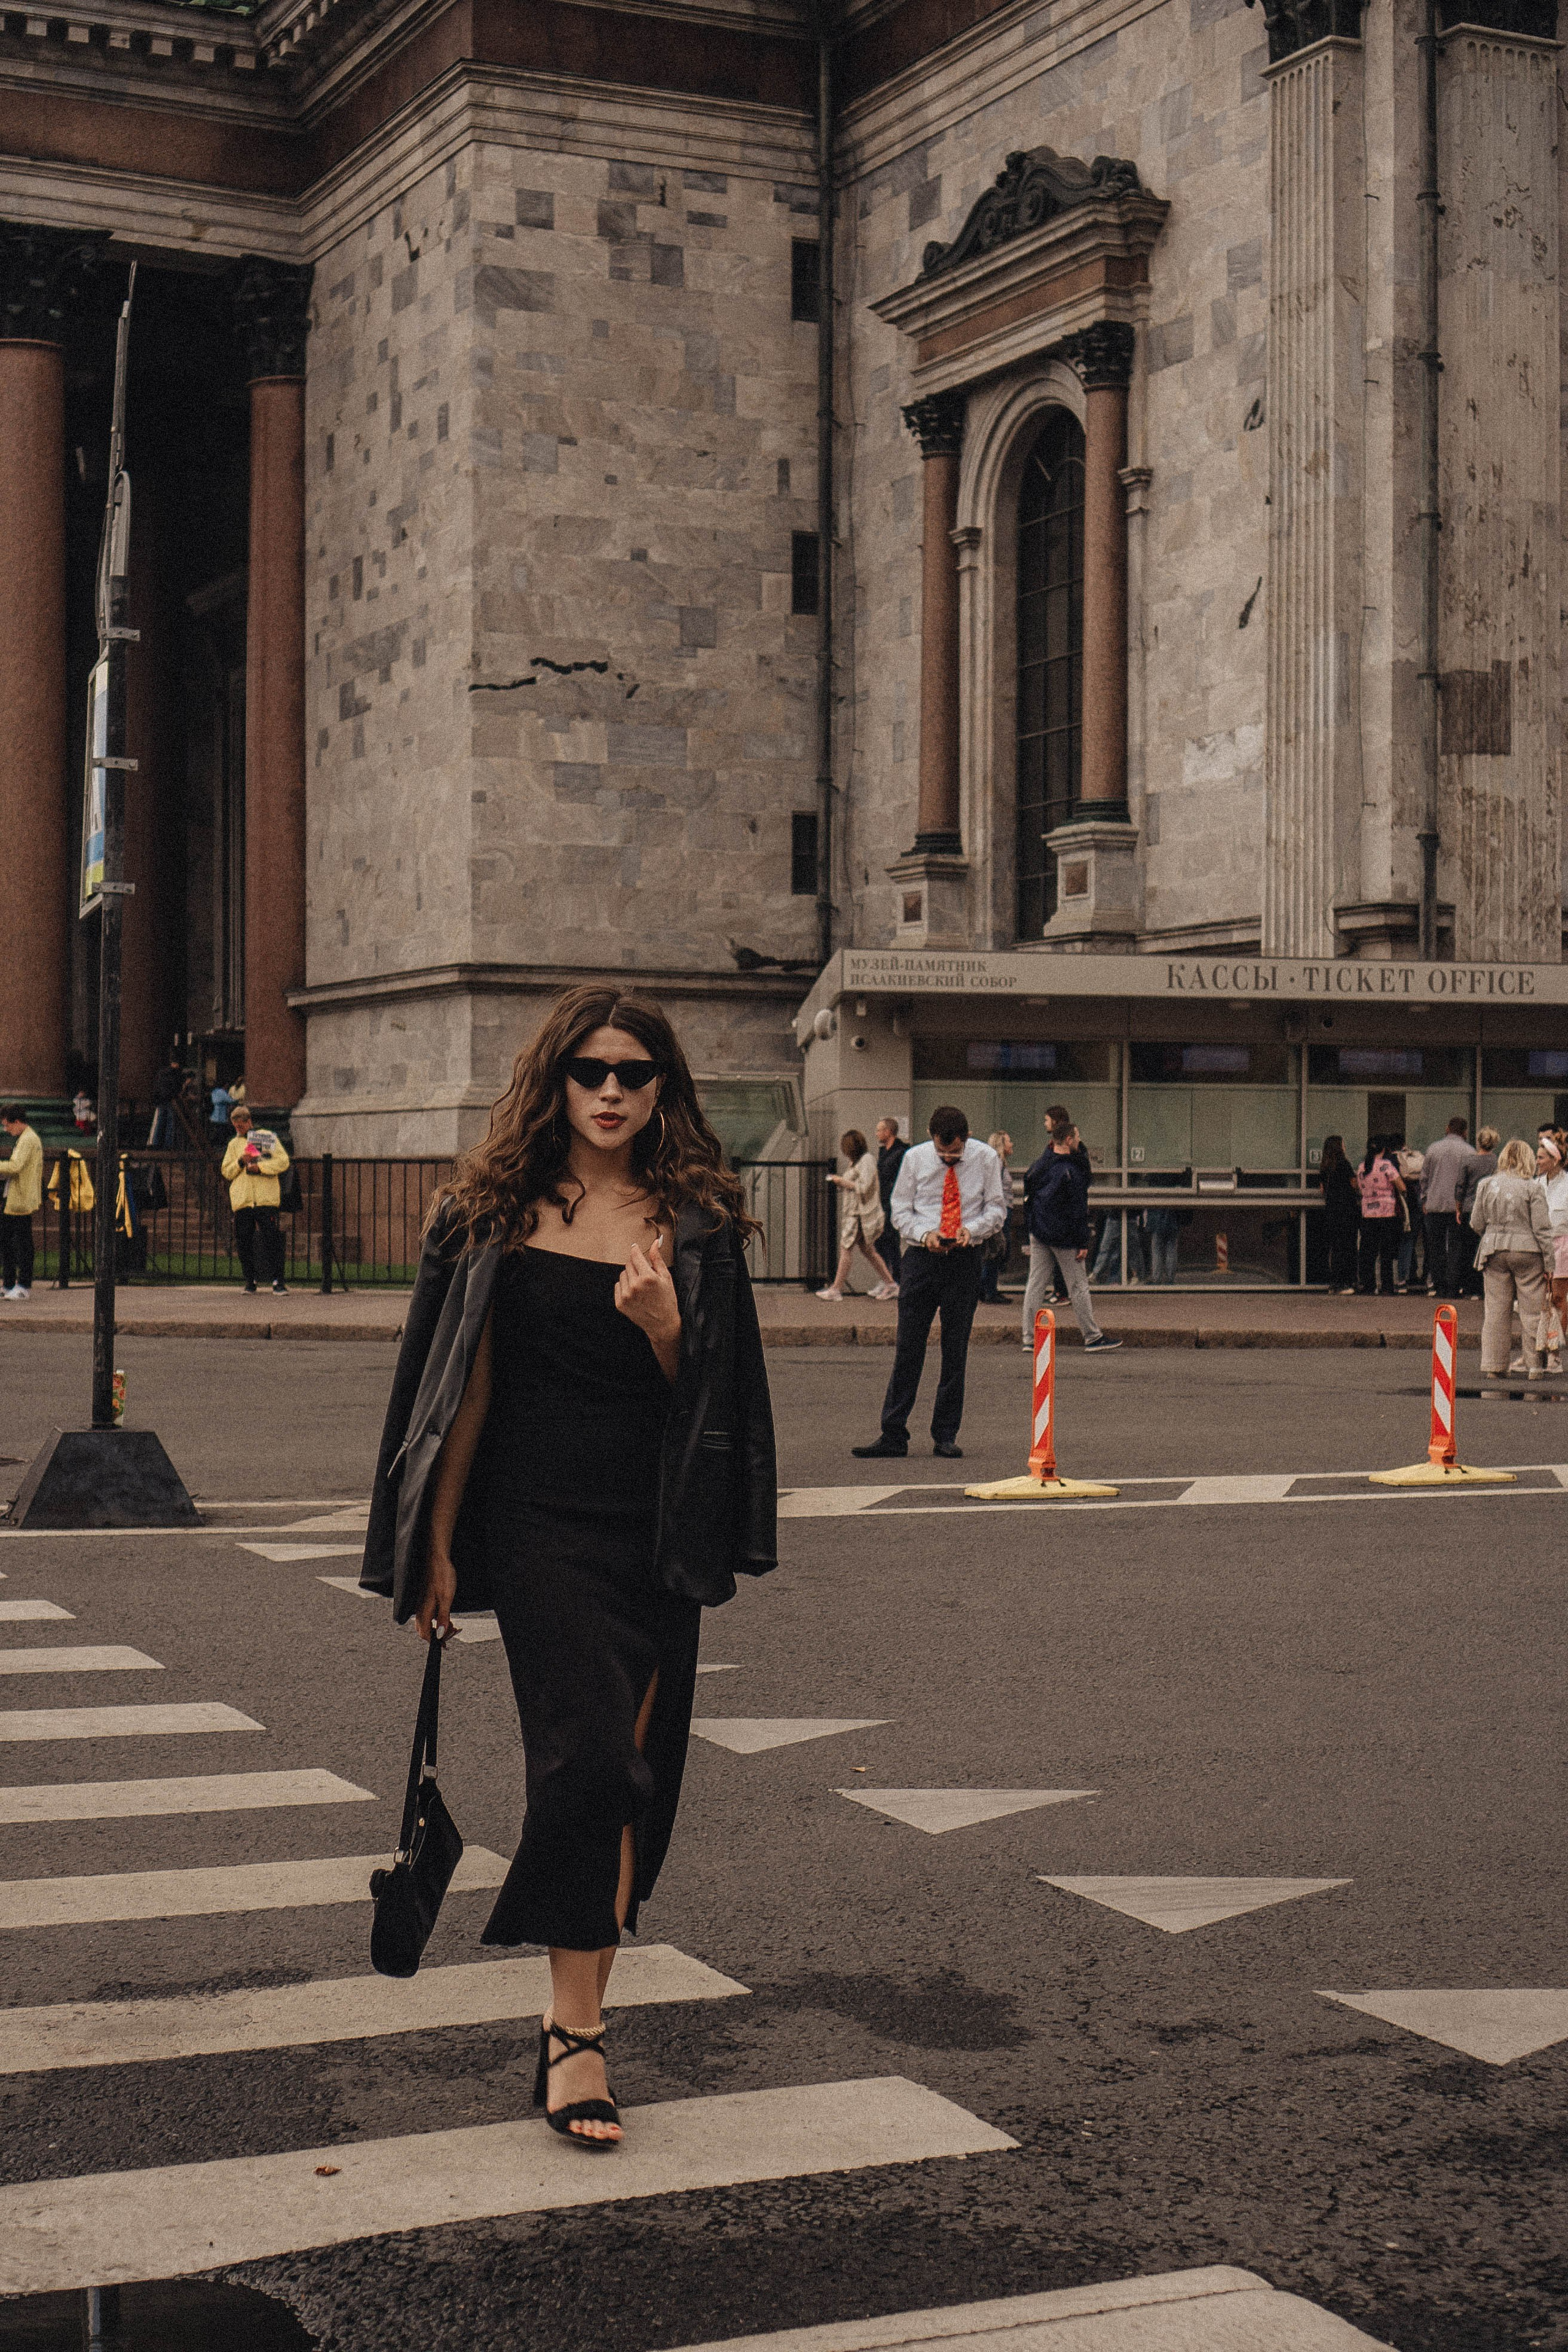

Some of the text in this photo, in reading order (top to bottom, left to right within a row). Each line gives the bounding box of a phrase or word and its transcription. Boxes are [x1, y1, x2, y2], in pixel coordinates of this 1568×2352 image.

[851, 956, 986, 972] МУЗЕЙ-ПАМЯТНИК
[851, 973, 1017, 988] ИСААКИЕВСКИЙ СОБОР
[1166, 964, 1535, 995] КАССЫ TICKET OFFICE
